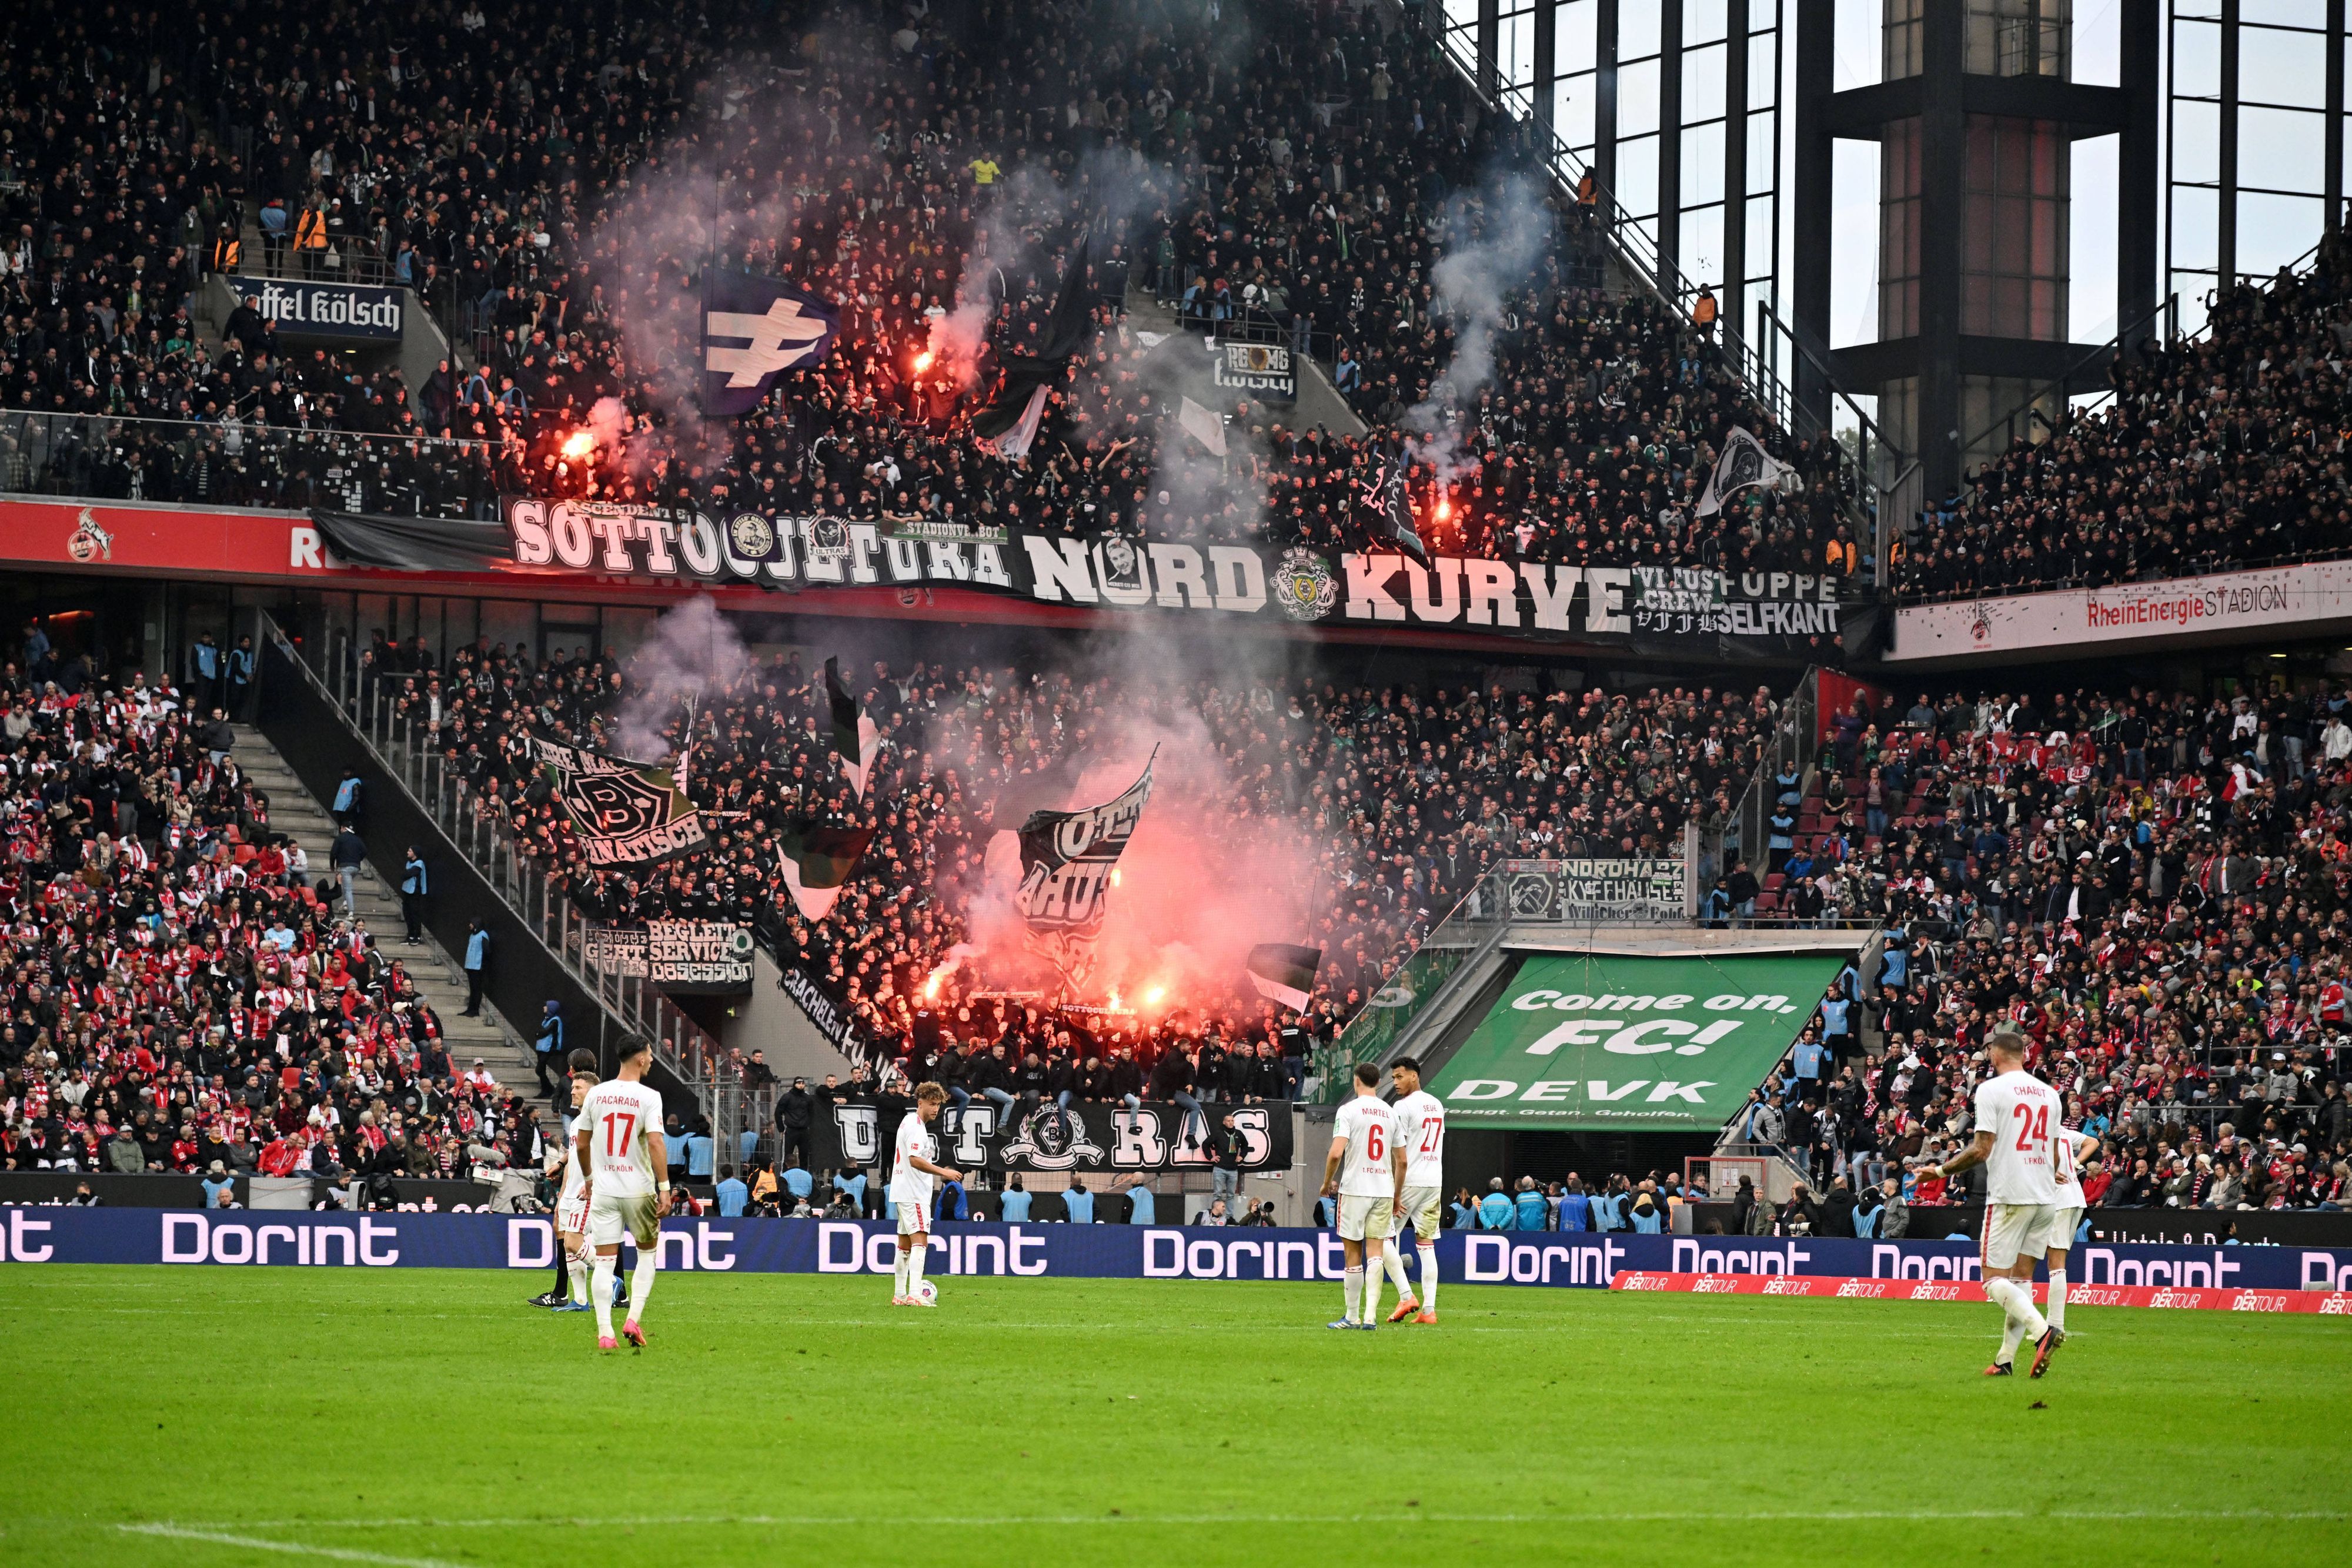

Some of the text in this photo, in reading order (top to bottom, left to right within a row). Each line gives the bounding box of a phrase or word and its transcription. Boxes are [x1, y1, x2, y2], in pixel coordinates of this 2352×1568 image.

[311, 290, 399, 332] Kölsch
[907, 521, 999, 538] STADIONVEBOT
[815, 547, 846, 555] ULTRAS
[1023, 535, 1267, 613] NORD
[1341, 553, 1631, 633] KURVE
[1644, 590, 1712, 613] CREW
[1718, 603, 1840, 634] SELFKANT
[647, 920, 735, 942] BEGLEIT
[649, 941, 731, 961] SERVICE
[1511, 989, 1798, 1014] Come on,
[1525, 1019, 1744, 1057] FC!
[596, 1095, 640, 1108] PACARADA
[1446, 1079, 1718, 1104] DEVK
[1362, 1108, 1390, 1119] MARTEL
[1519, 1109, 1585, 1117] Getan.
[1595, 1109, 1695, 1118] Geholfen.
[2013, 1103, 2049, 1152] 24
[603, 1112, 636, 1158] 17
[1368, 1124, 1384, 1161] 6
[1420, 1118, 1442, 1152] 27
[162, 1213, 399, 1266] Dorint
[1144, 1230, 1346, 1279] Dorint
[1673, 1239, 1810, 1275] Dorint
[1465, 1235, 1625, 1285] Dorint
[1873, 1245, 1983, 1282] Dorin
[2085, 1249, 2240, 1289] Dorint
